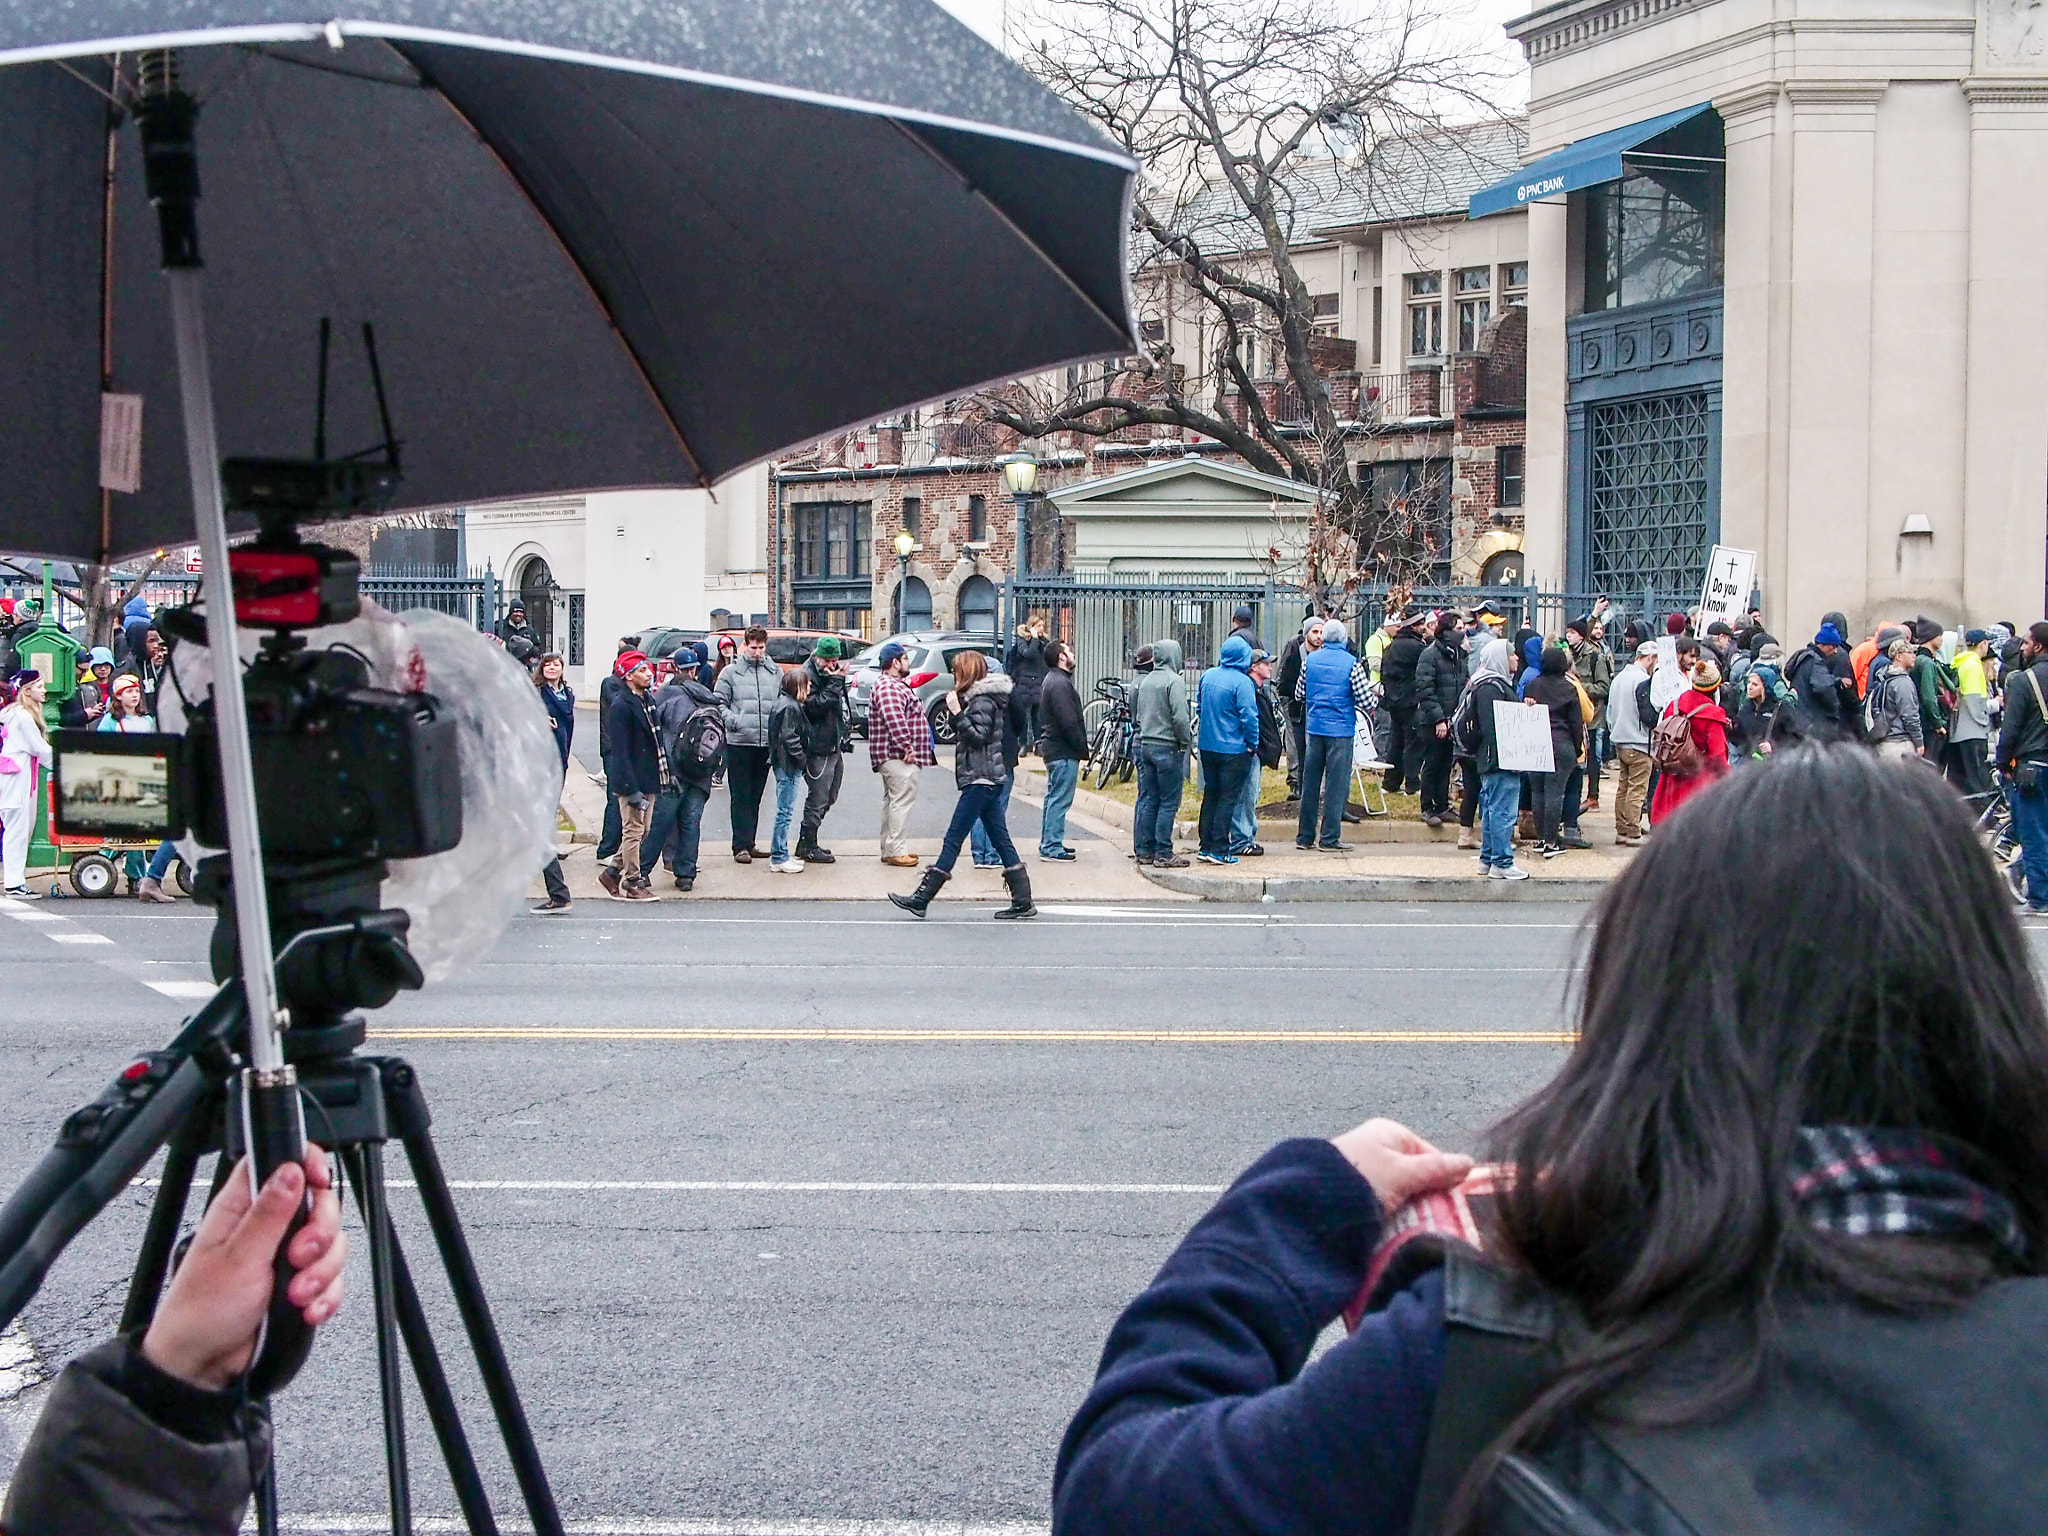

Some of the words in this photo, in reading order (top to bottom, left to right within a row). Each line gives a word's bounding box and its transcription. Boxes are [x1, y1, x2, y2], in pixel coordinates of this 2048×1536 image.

[1526, 181, 1543, 198] PNC
[1543, 175, 1564, 193] BANK
[1712, 577, 1723, 593] Do
[1722, 582, 1738, 599] you
[1706, 595, 1728, 614] know
